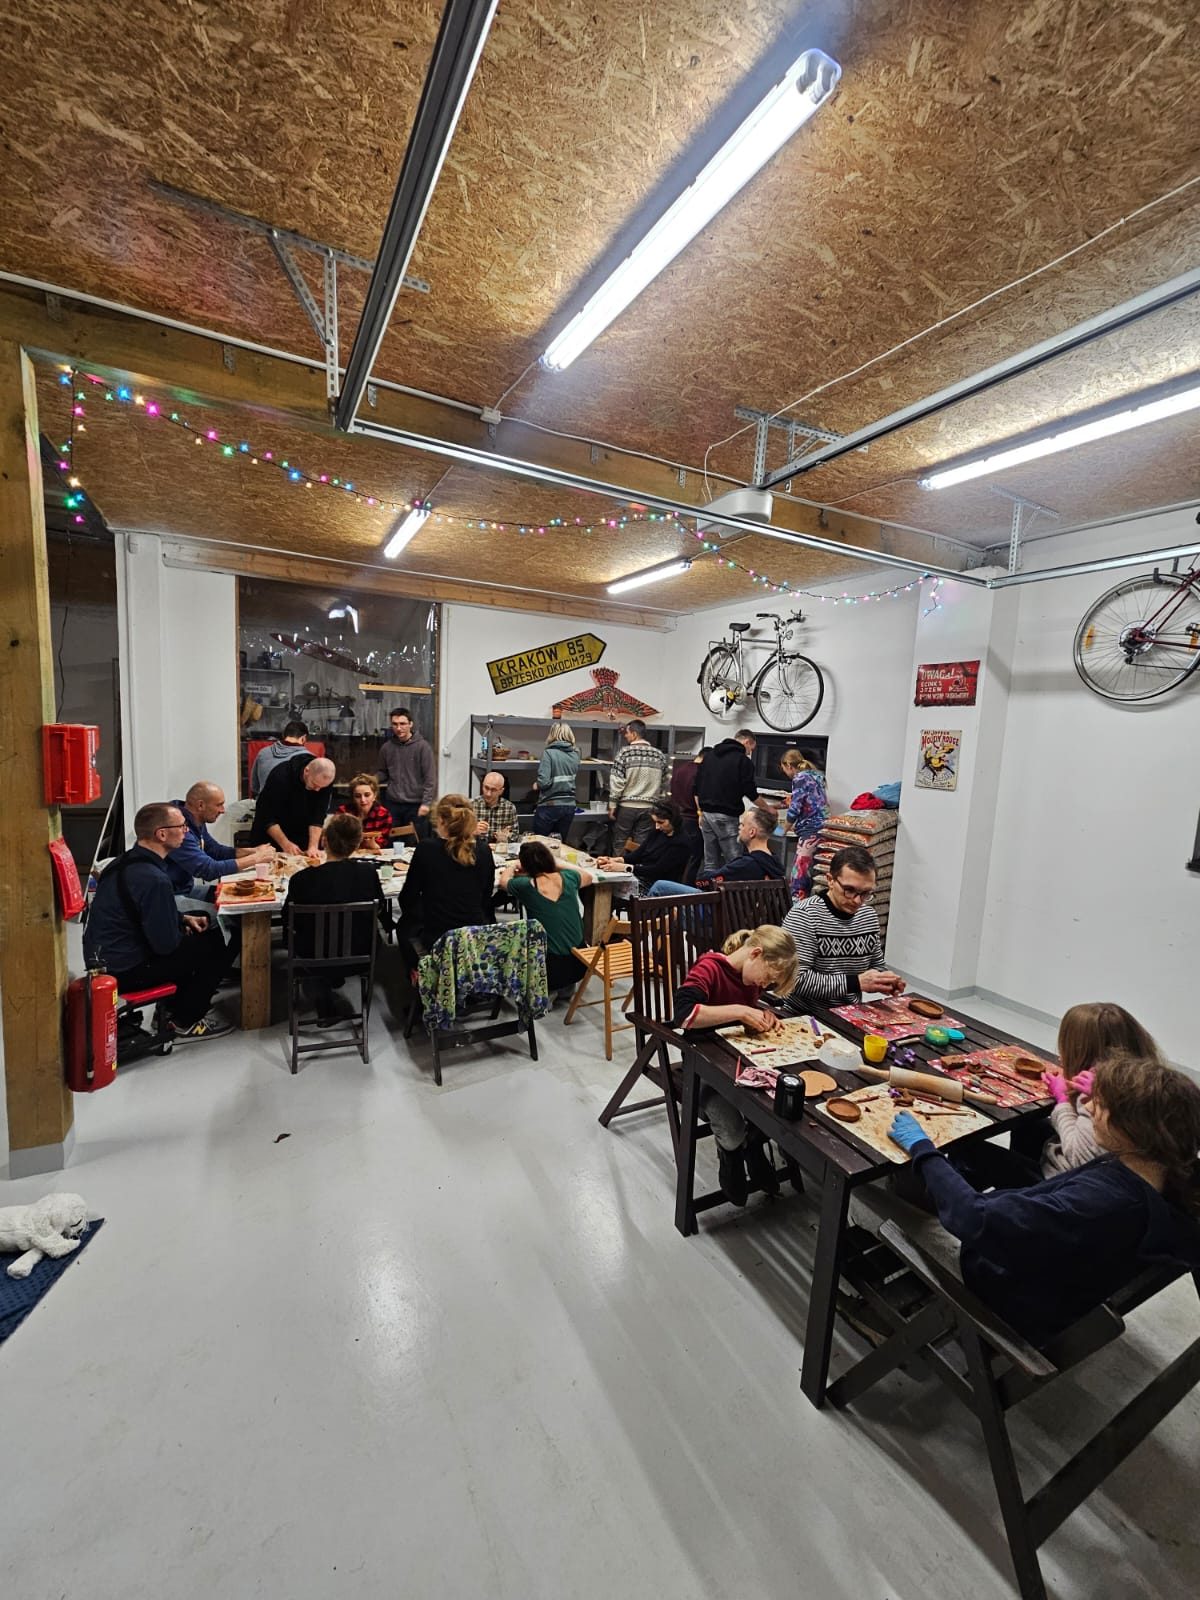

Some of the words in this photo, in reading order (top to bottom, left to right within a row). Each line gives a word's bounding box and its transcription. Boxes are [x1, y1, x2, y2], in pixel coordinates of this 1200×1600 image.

[567, 639, 585, 656] 85
[500, 668, 545, 690] BRZESKO
[546, 658, 579, 675] OKOCIM
[579, 653, 593, 665] 29
